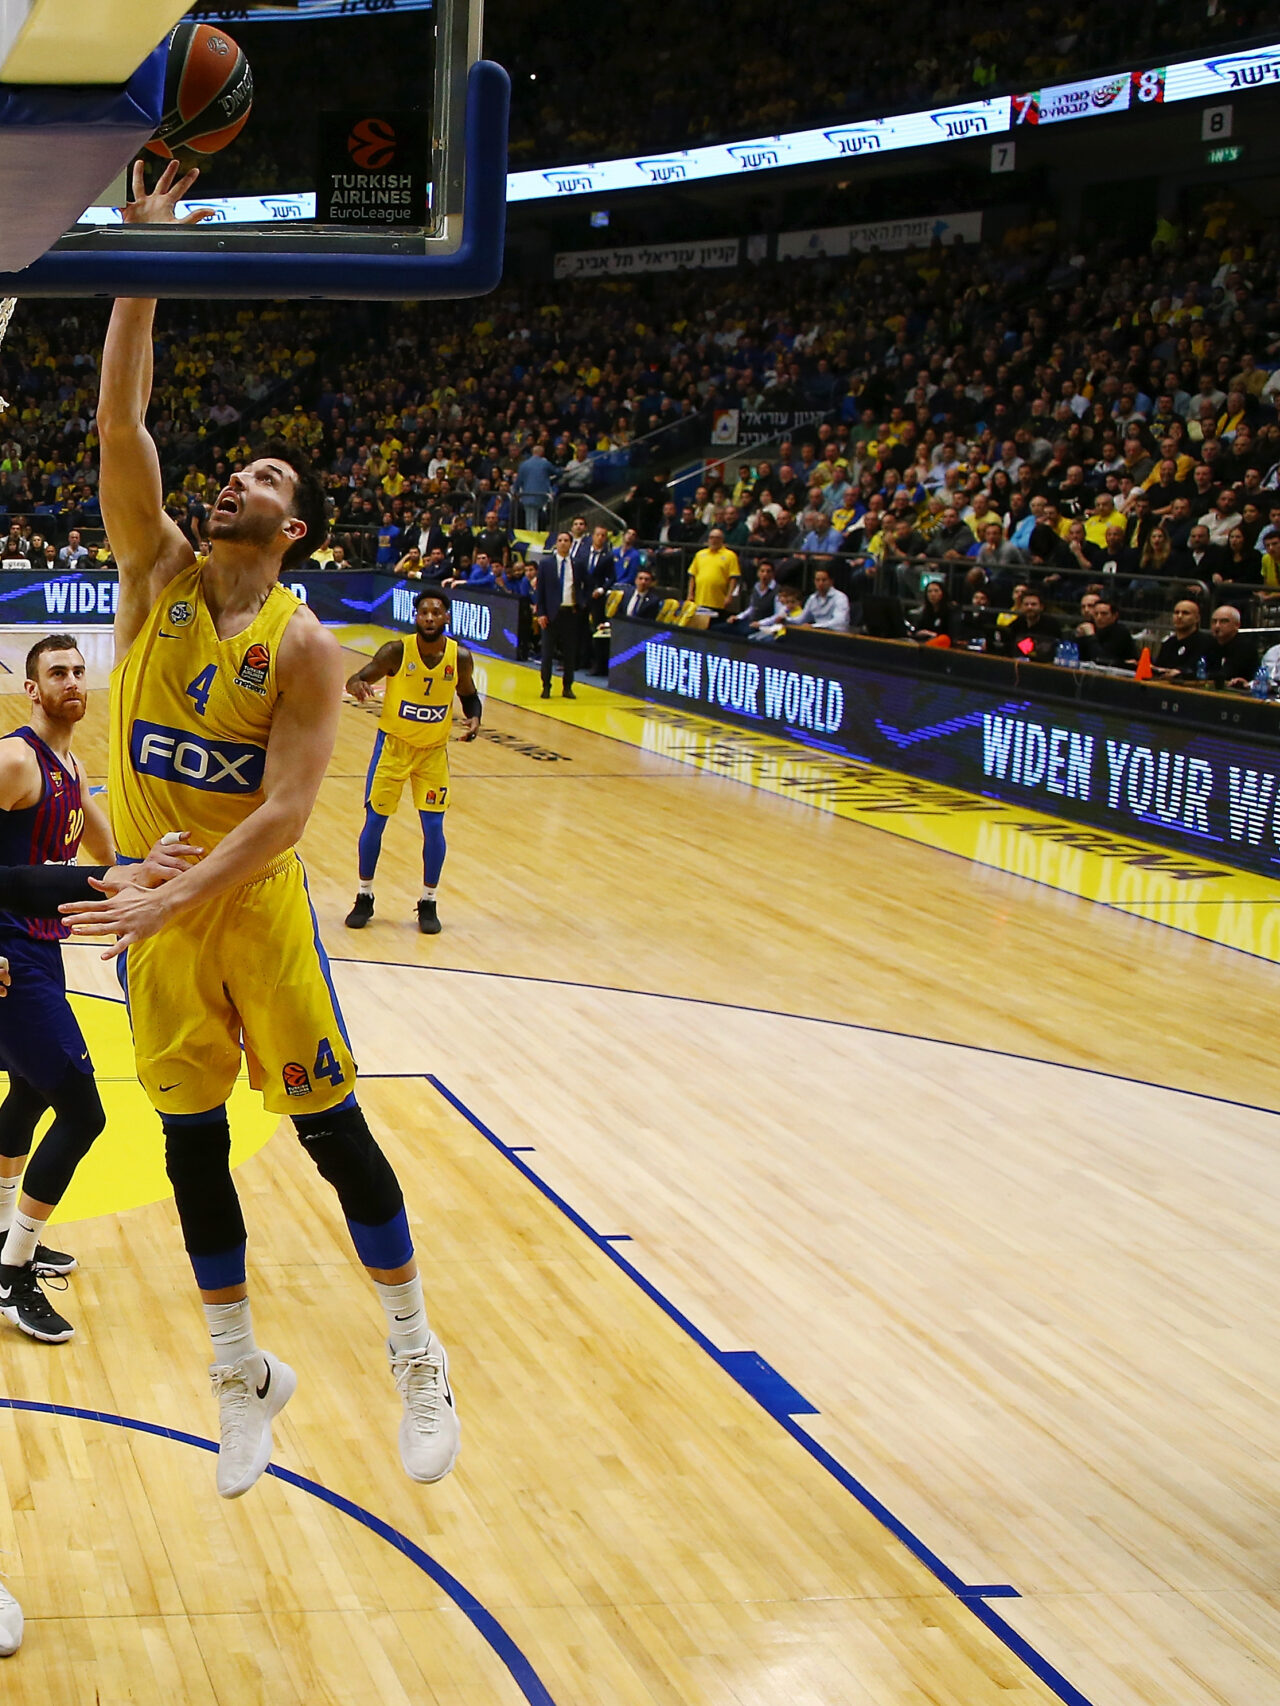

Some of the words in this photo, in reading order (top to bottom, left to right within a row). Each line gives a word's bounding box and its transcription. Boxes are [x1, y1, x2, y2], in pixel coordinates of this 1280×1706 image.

[1138, 70, 1159, 102] 8
[1015, 94, 1032, 125] 7
[945, 116, 988, 137] הישג
[1210, 112, 1223, 132] 8
[839, 134, 881, 154] הישג
[740, 150, 778, 169] הישג
[999, 149, 1008, 167] 7
[331, 174, 412, 188] TURKISH
[651, 165, 686, 182] הישג
[555, 177, 593, 193] הישג
[330, 190, 412, 204] AIRLINES
[329, 206, 411, 222] EuroLeague
[393, 588, 419, 625] WIDE
[452, 600, 491, 641] WORLD
[185, 663, 219, 717] 4
[423, 677, 433, 696] 7
[645, 641, 703, 700] WIDEN
[706, 654, 760, 715] YOUR
[764, 666, 844, 734] WORLD
[402, 704, 447, 722] FOX
[139, 733, 255, 786] FOX
[982, 713, 1095, 801] WIDEN
[1106, 739, 1213, 833] YOUR
[439, 787, 448, 805] 7
[64, 807, 85, 846] 30
[993, 820, 1234, 881] ARENA
[313, 1037, 345, 1087] 4
